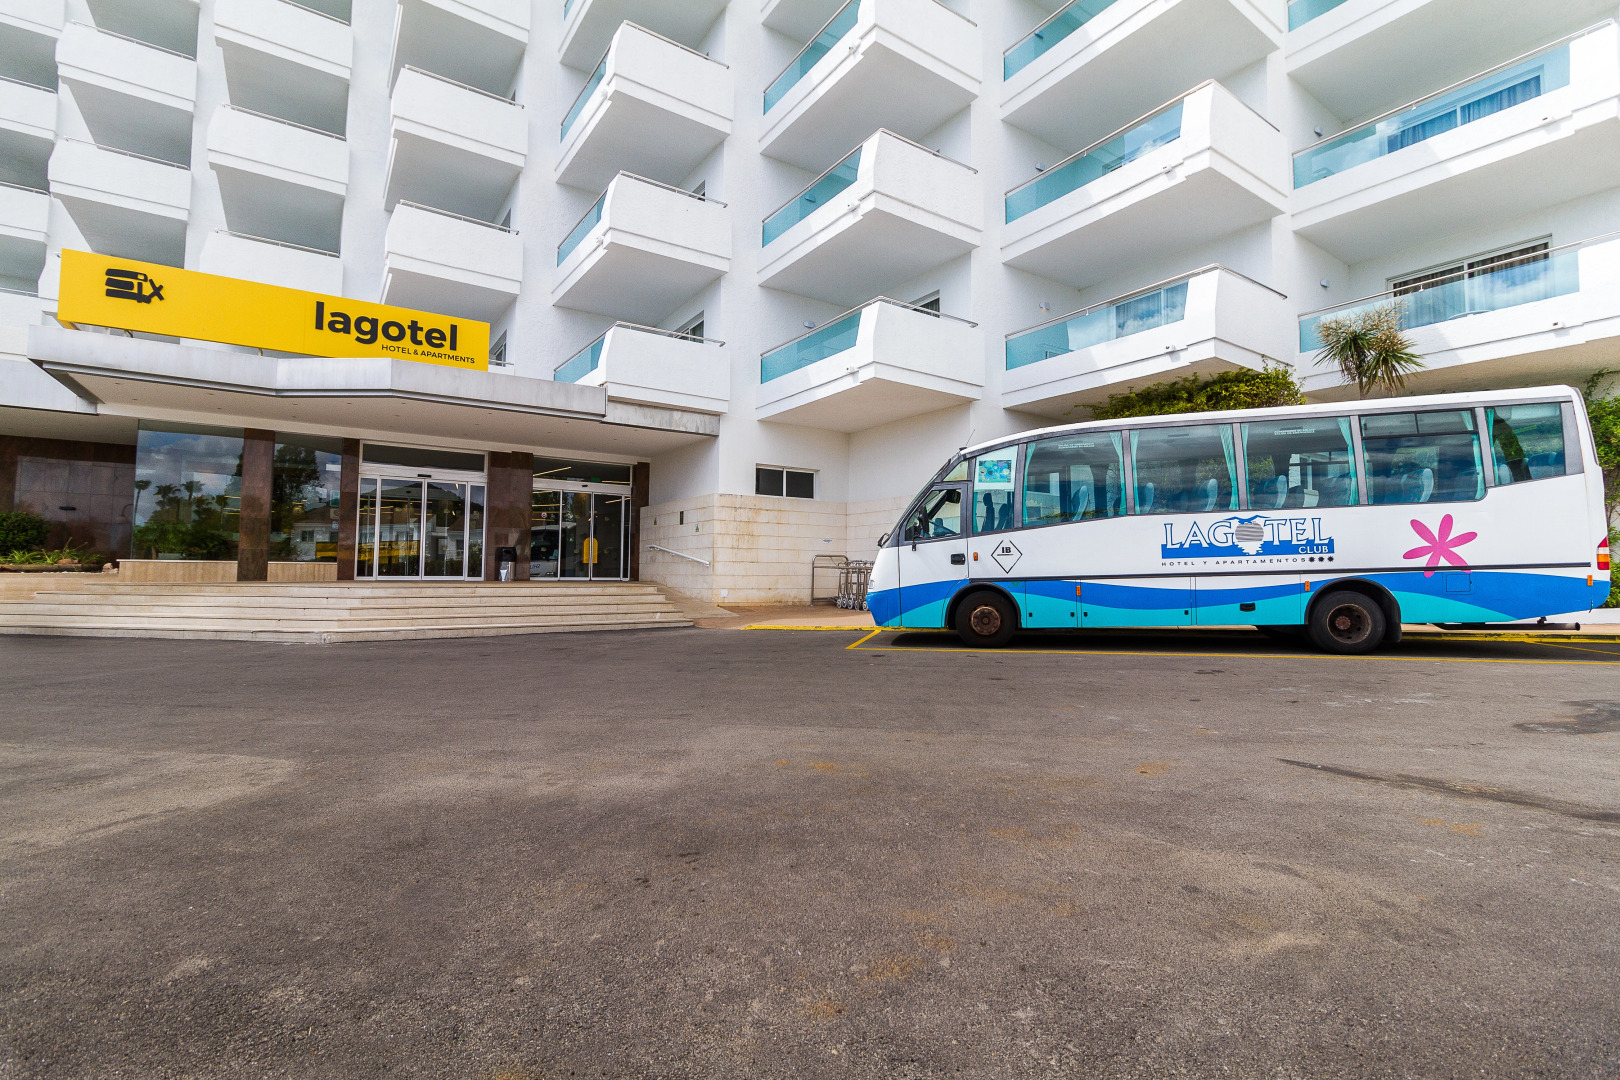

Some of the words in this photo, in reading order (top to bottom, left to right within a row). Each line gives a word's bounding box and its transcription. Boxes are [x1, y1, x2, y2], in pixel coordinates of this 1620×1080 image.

[315, 301, 457, 351] lagotel
[381, 344, 411, 354] HOTEL
[420, 350, 475, 363] APARTMENTS
[1001, 546, 1012, 554] IB
[1298, 545, 1329, 554] CLUB
[1215, 557, 1306, 565] APARTAMENTOS
